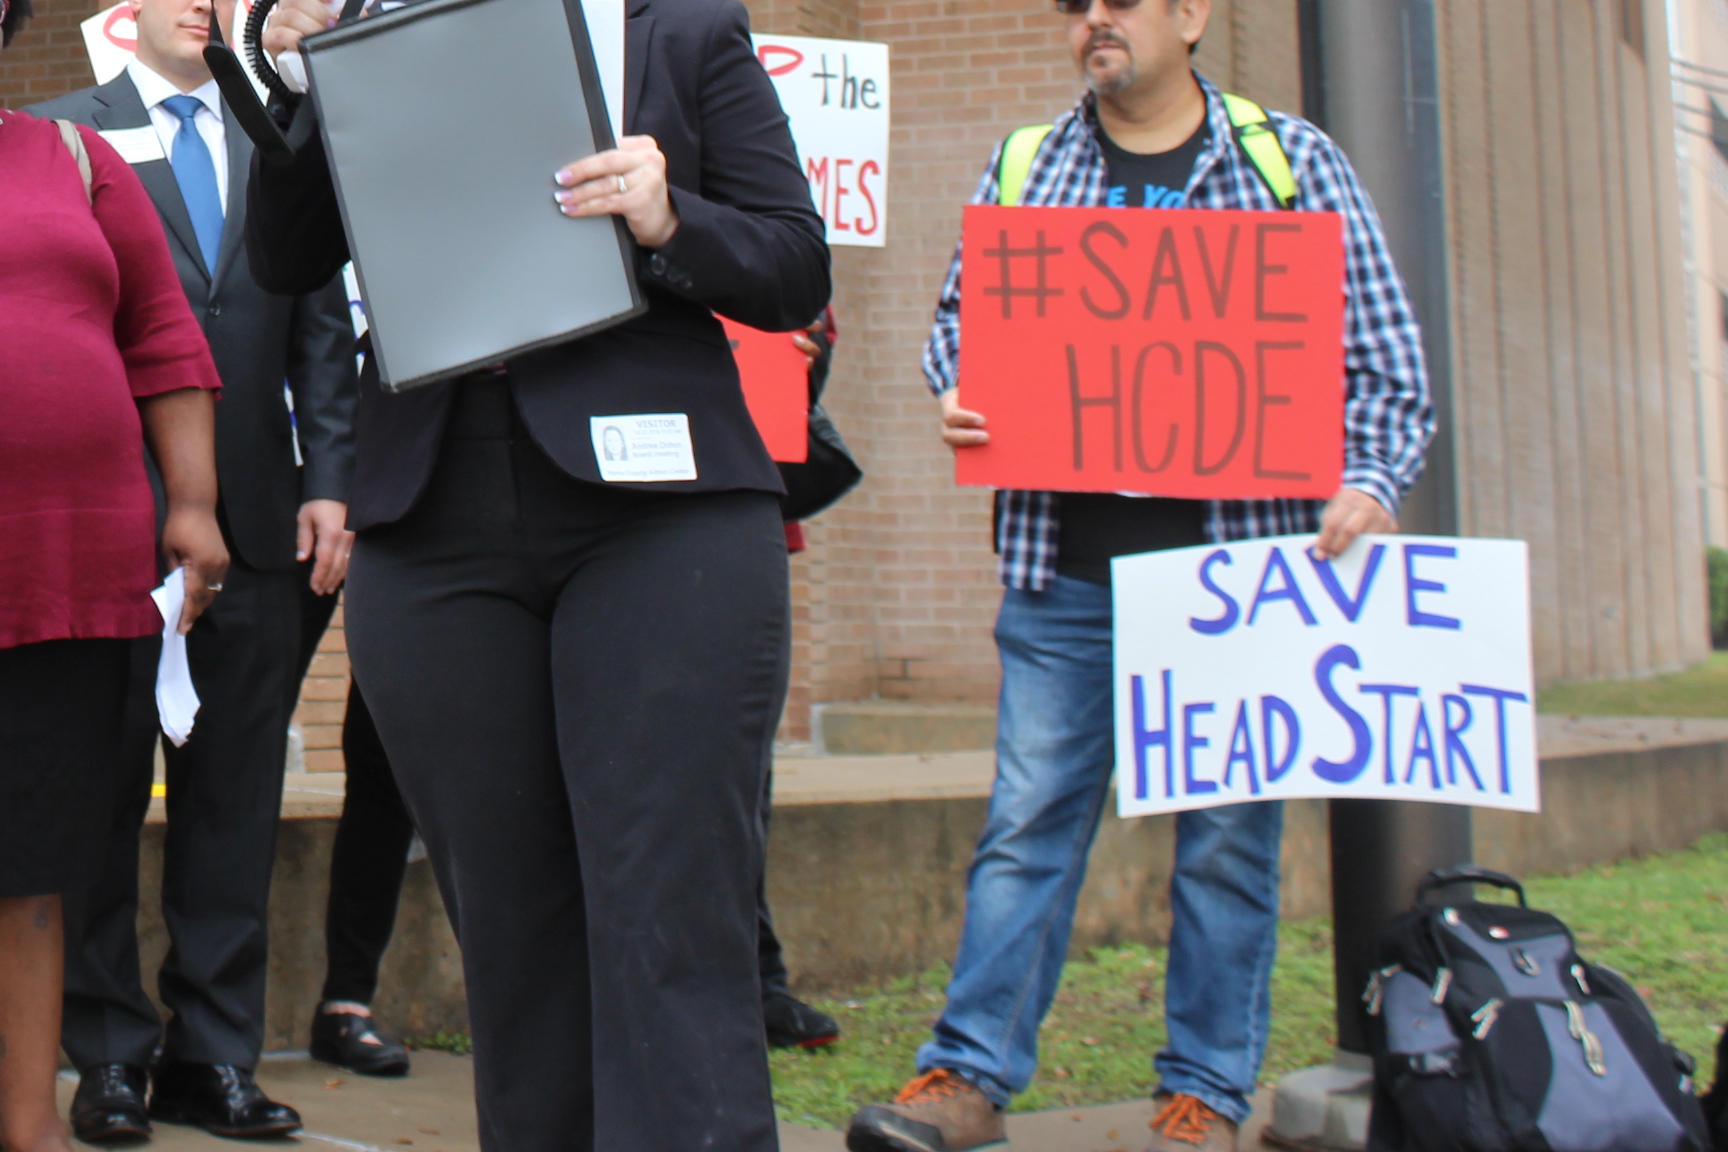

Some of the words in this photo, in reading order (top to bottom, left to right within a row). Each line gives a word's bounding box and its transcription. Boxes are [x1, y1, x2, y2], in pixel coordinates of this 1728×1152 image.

[810, 53, 881, 110] the
[983, 221, 1308, 323] #SAVE
[635, 419, 677, 428] VISITOR
[1065, 339, 1311, 482] HCDE
[1189, 543, 1462, 636] SAVE
